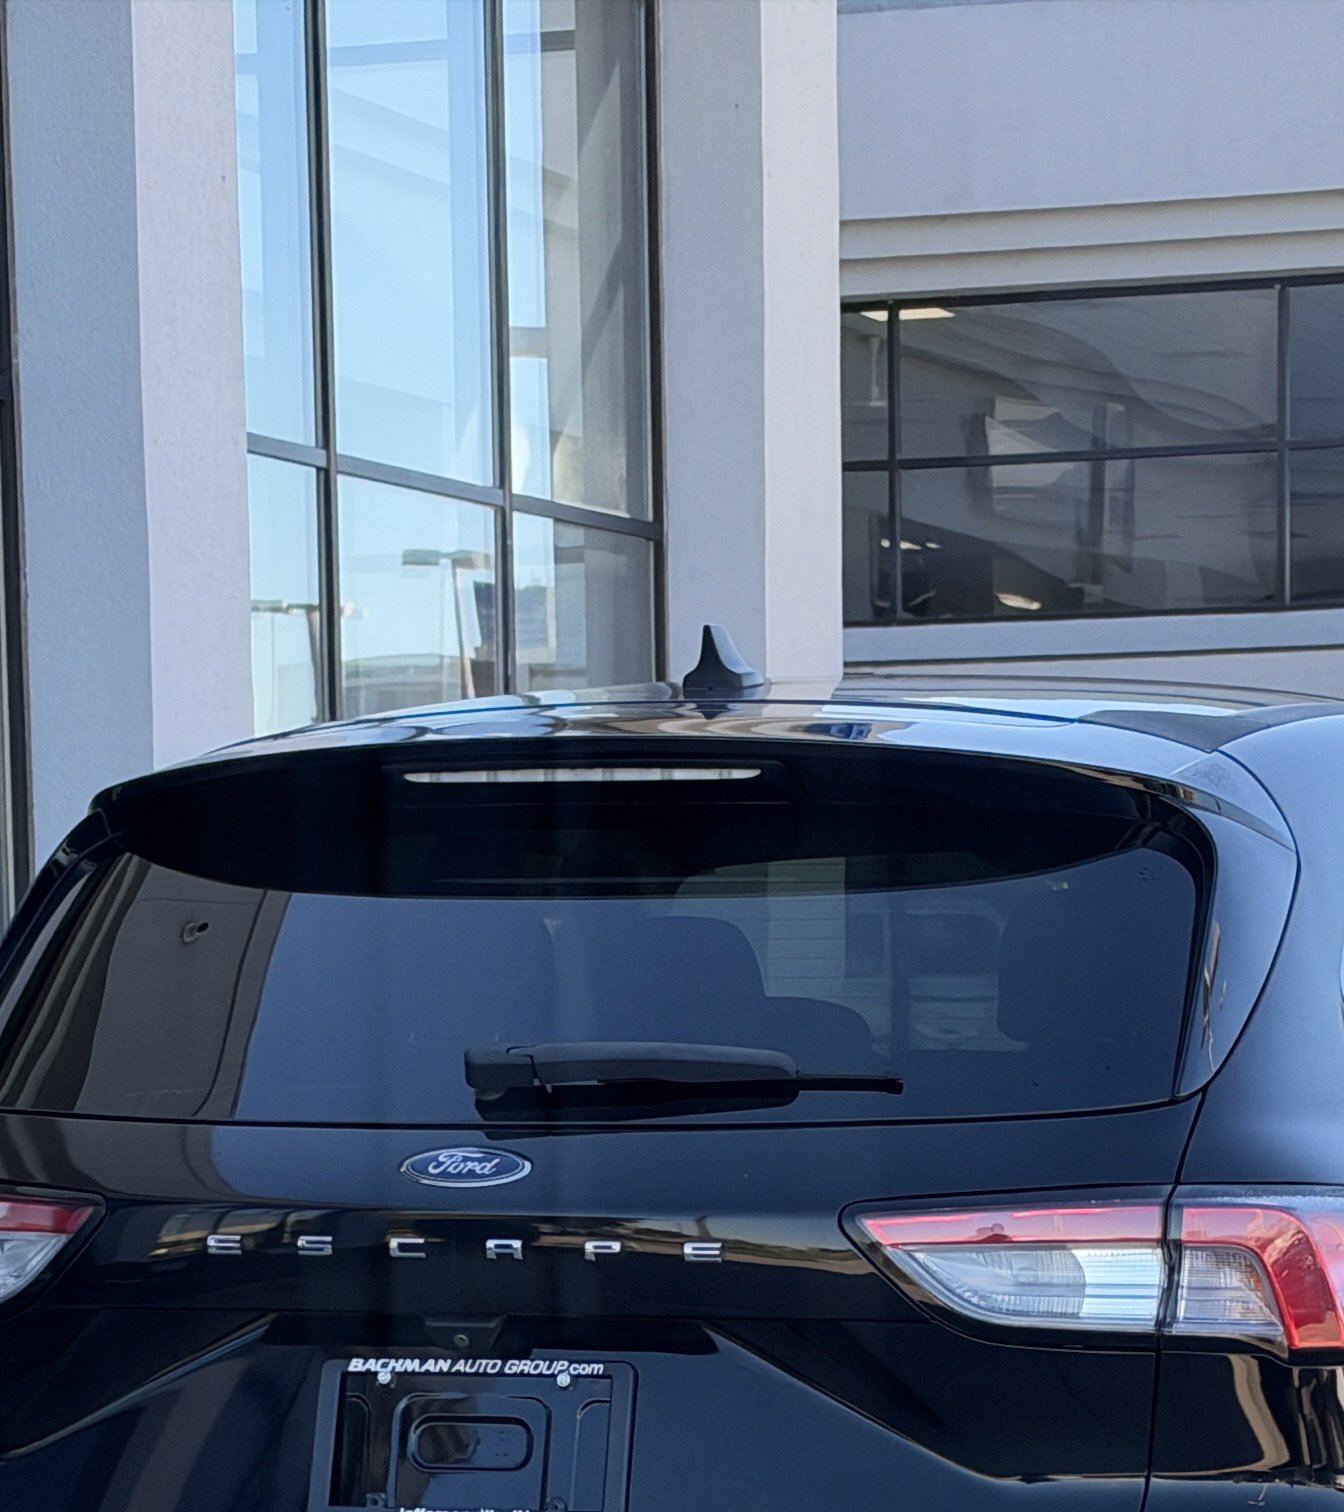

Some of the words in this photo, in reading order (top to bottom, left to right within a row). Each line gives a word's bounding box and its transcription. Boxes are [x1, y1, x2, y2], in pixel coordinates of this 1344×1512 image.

[428, 1150, 498, 1175] Ford
[206, 1234, 722, 1262] ESCAPE
[347, 1357, 452, 1374] BACHMAN
[451, 1358, 502, 1374] AUTO
